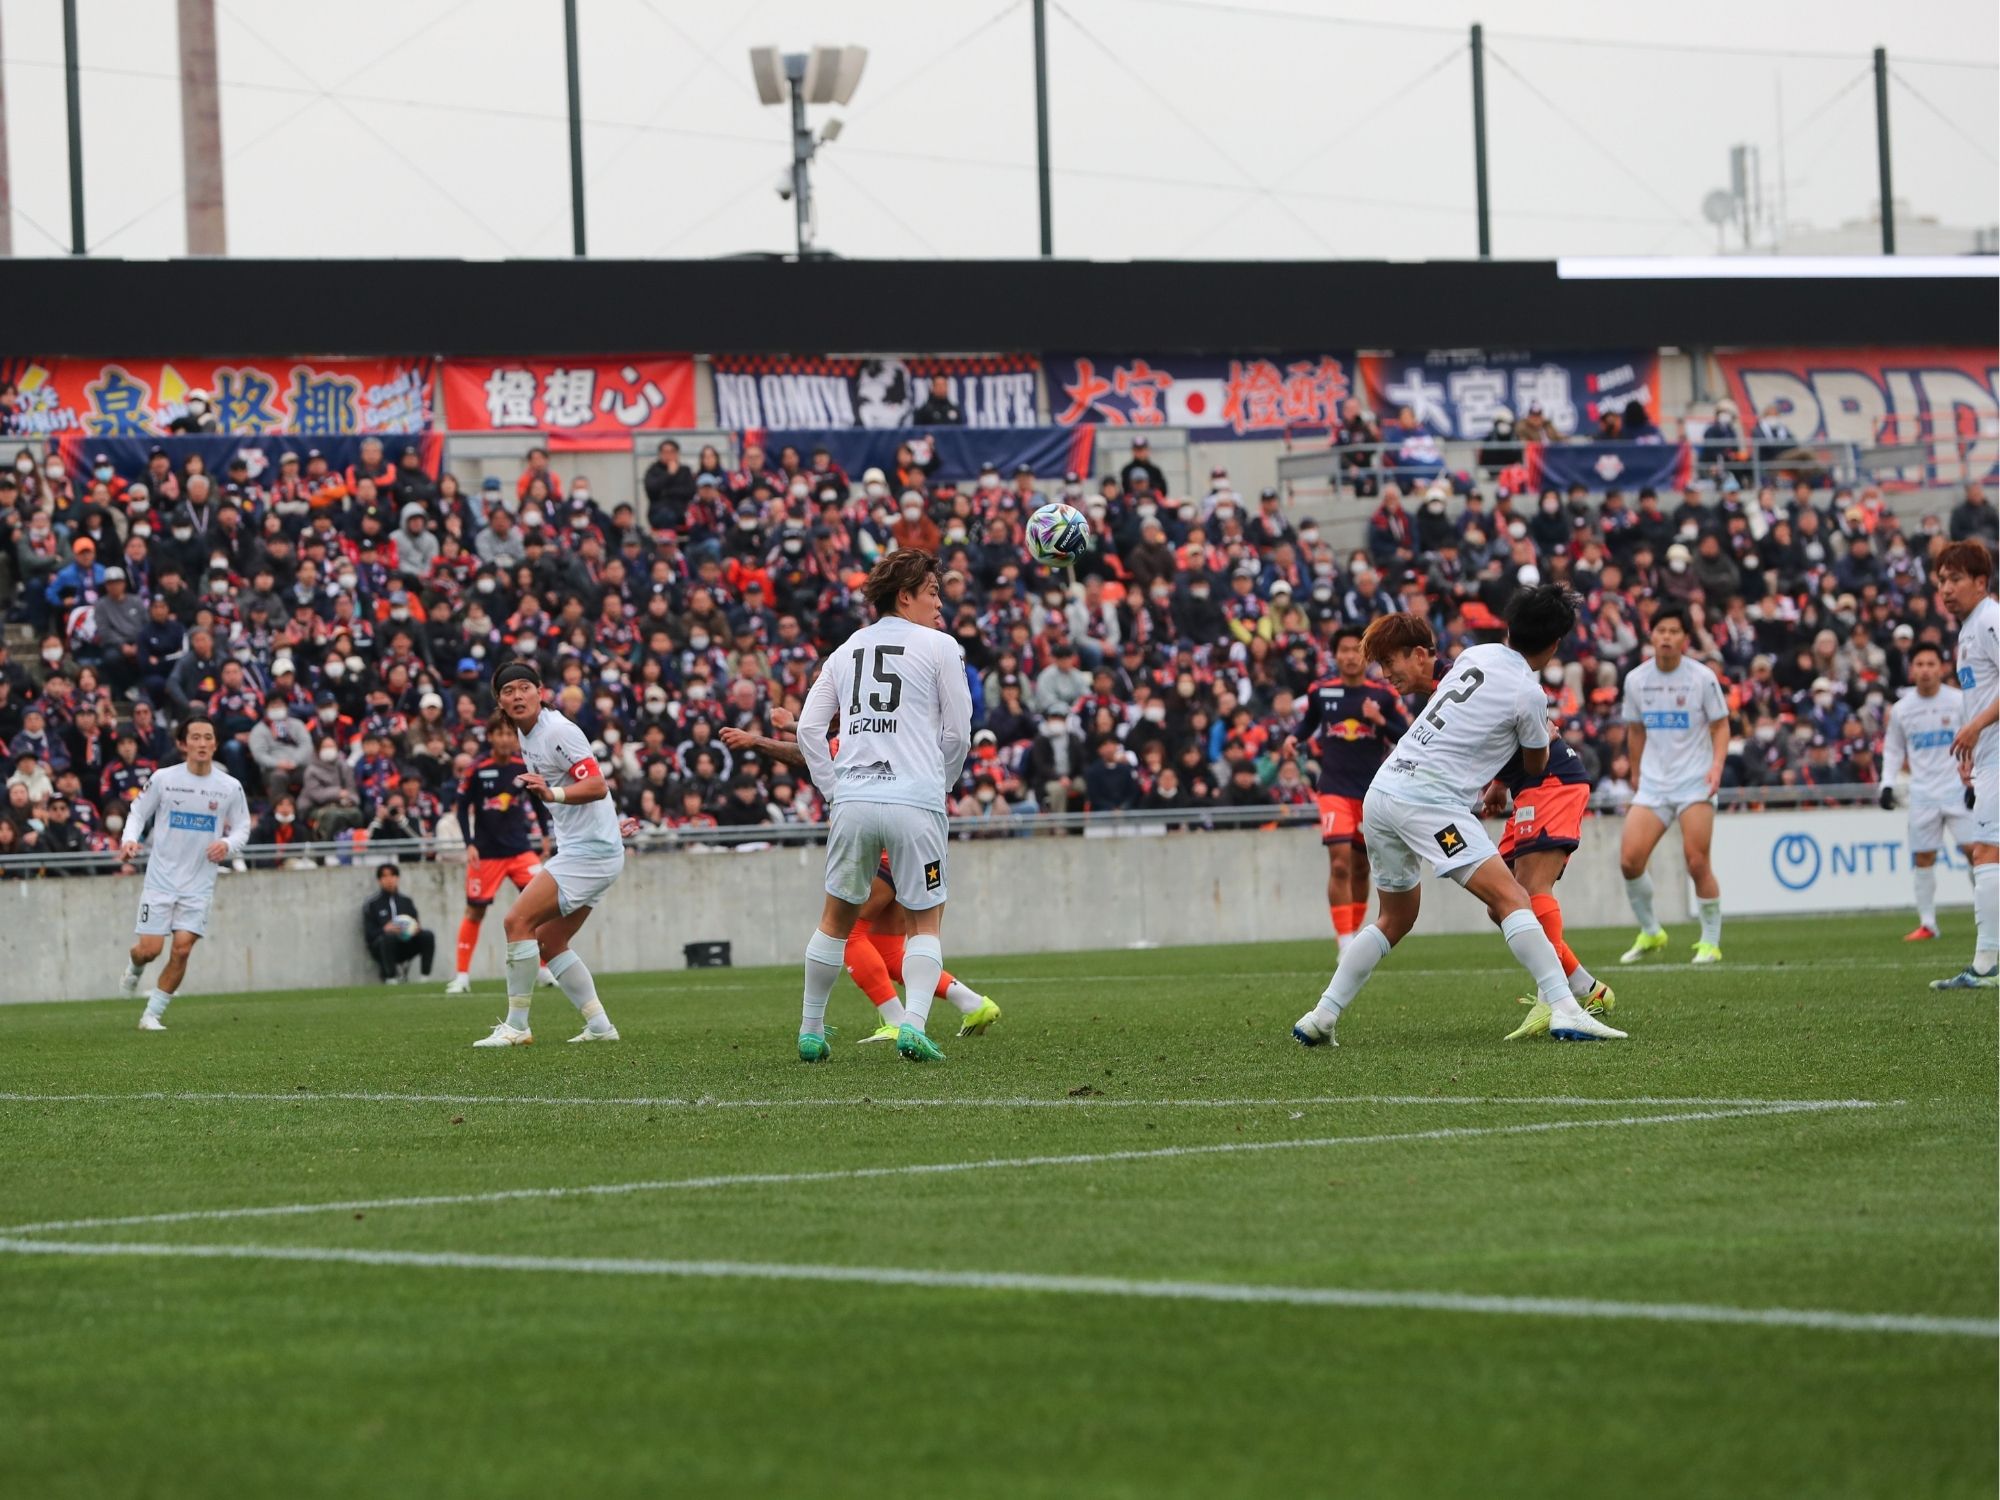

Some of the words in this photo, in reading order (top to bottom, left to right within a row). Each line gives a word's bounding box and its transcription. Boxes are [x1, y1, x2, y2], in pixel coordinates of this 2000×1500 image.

[484, 365, 665, 428] 橙想心
[715, 373, 761, 429] NO
[963, 373, 1037, 429] LIFE
[1054, 357, 1174, 428] 大宮
[1383, 362, 1579, 440] 大宮魂
[1738, 368, 1999, 484] PRID
[849, 644, 906, 716] 15
[1425, 665, 1485, 731] 2
[1411, 724, 1435, 746] RYU
[574, 764, 589, 780] C
[1831, 841, 1902, 875] NTT
